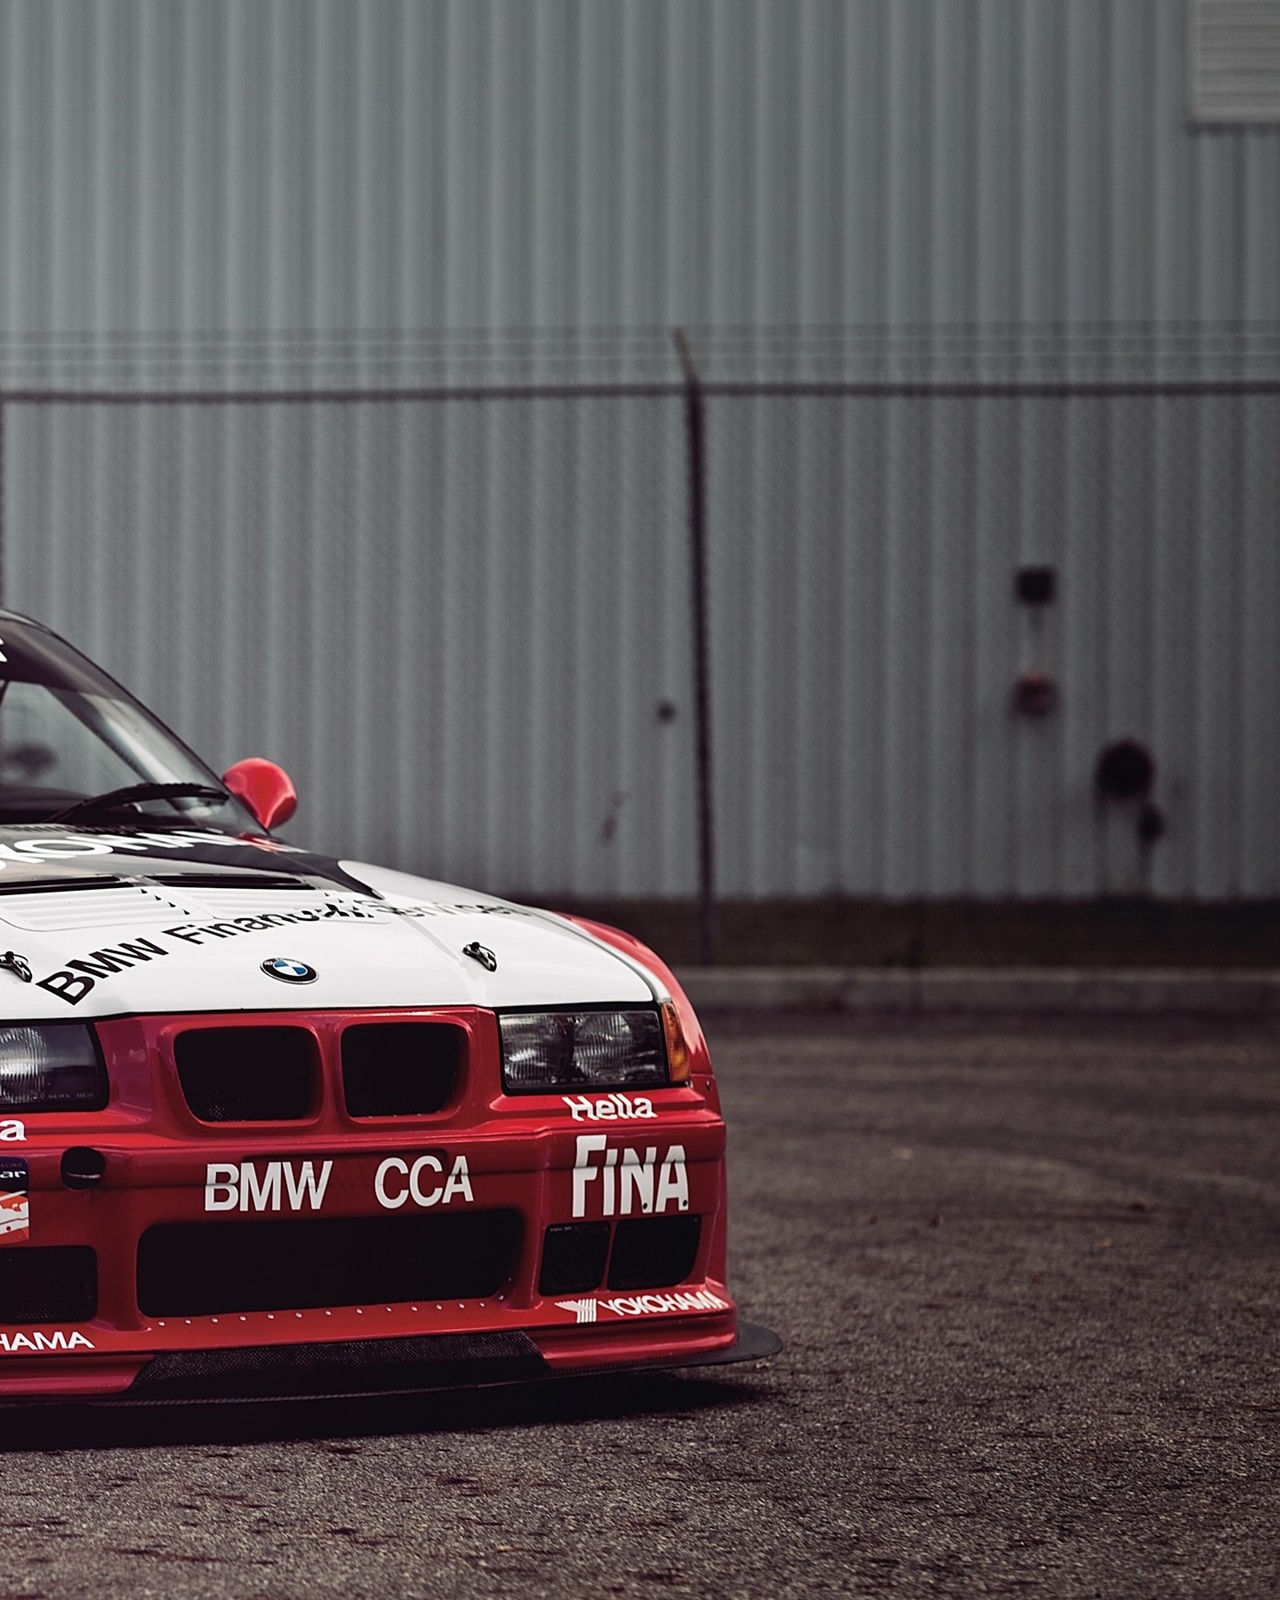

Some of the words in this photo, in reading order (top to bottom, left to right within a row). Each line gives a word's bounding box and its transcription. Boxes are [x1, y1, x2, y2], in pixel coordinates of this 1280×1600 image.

[35, 937, 169, 1006] BMW
[562, 1094, 658, 1121] Hella
[205, 1160, 333, 1212] BMW
[374, 1155, 474, 1209] CCA
[572, 1135, 689, 1217] FINA
[598, 1290, 729, 1316] YOKOHAMA
